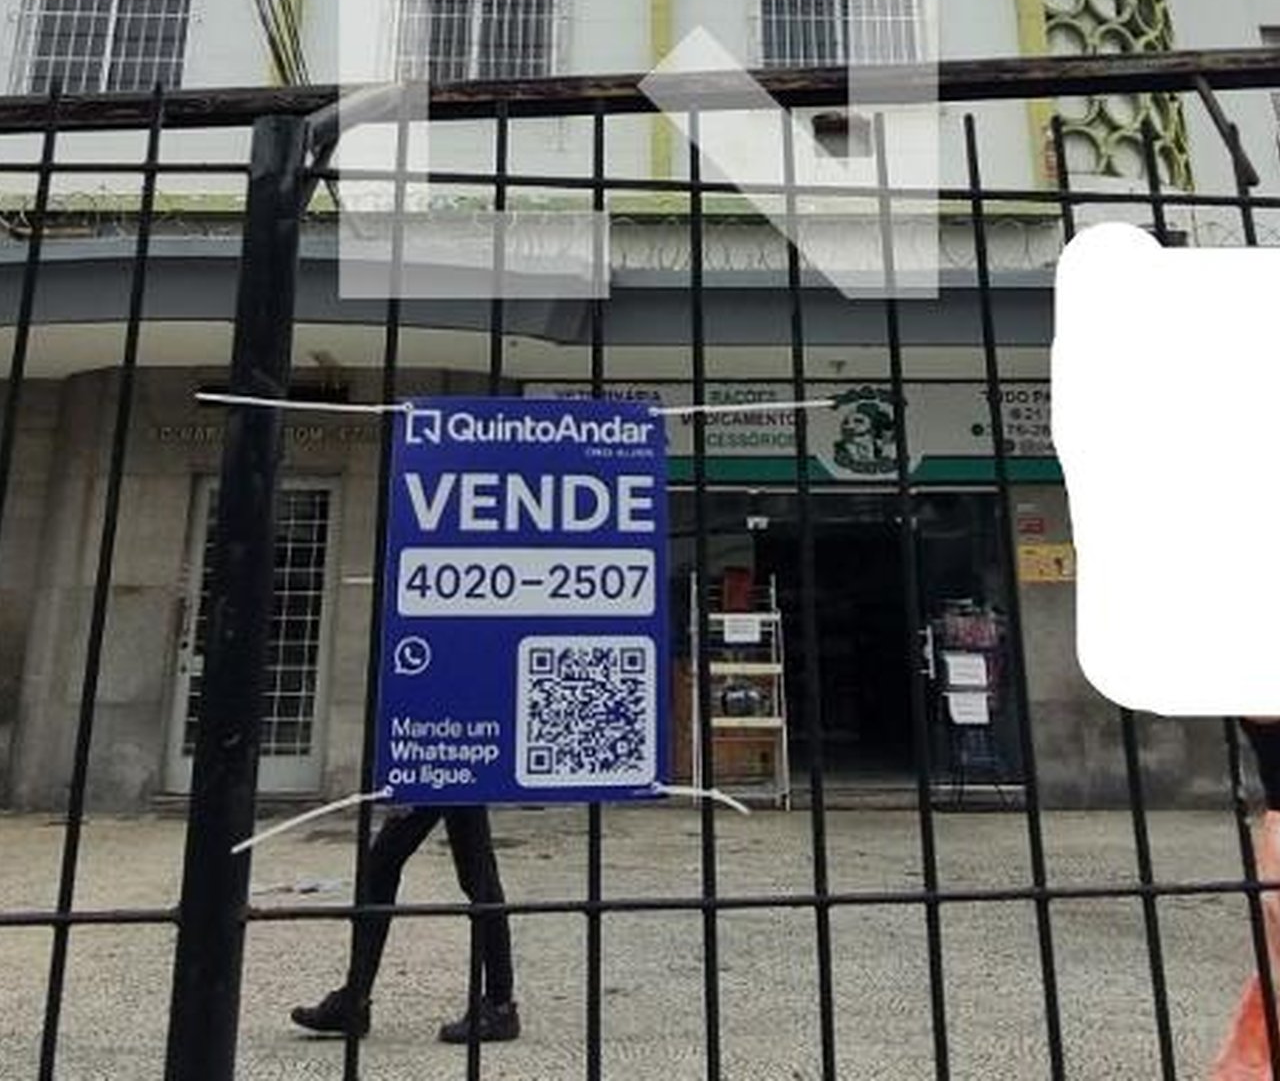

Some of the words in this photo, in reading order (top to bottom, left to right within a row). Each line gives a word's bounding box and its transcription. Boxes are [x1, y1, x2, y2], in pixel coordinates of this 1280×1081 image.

[447, 413, 654, 443] QuintoAndar
[405, 473, 656, 532] VENDE
[405, 564, 649, 599] 4020-2507
[391, 717, 463, 738] Mande
[467, 721, 500, 737] um
[390, 741, 499, 764] Whatsapp
[388, 768, 416, 785] ou
[419, 765, 477, 790] ligue.
